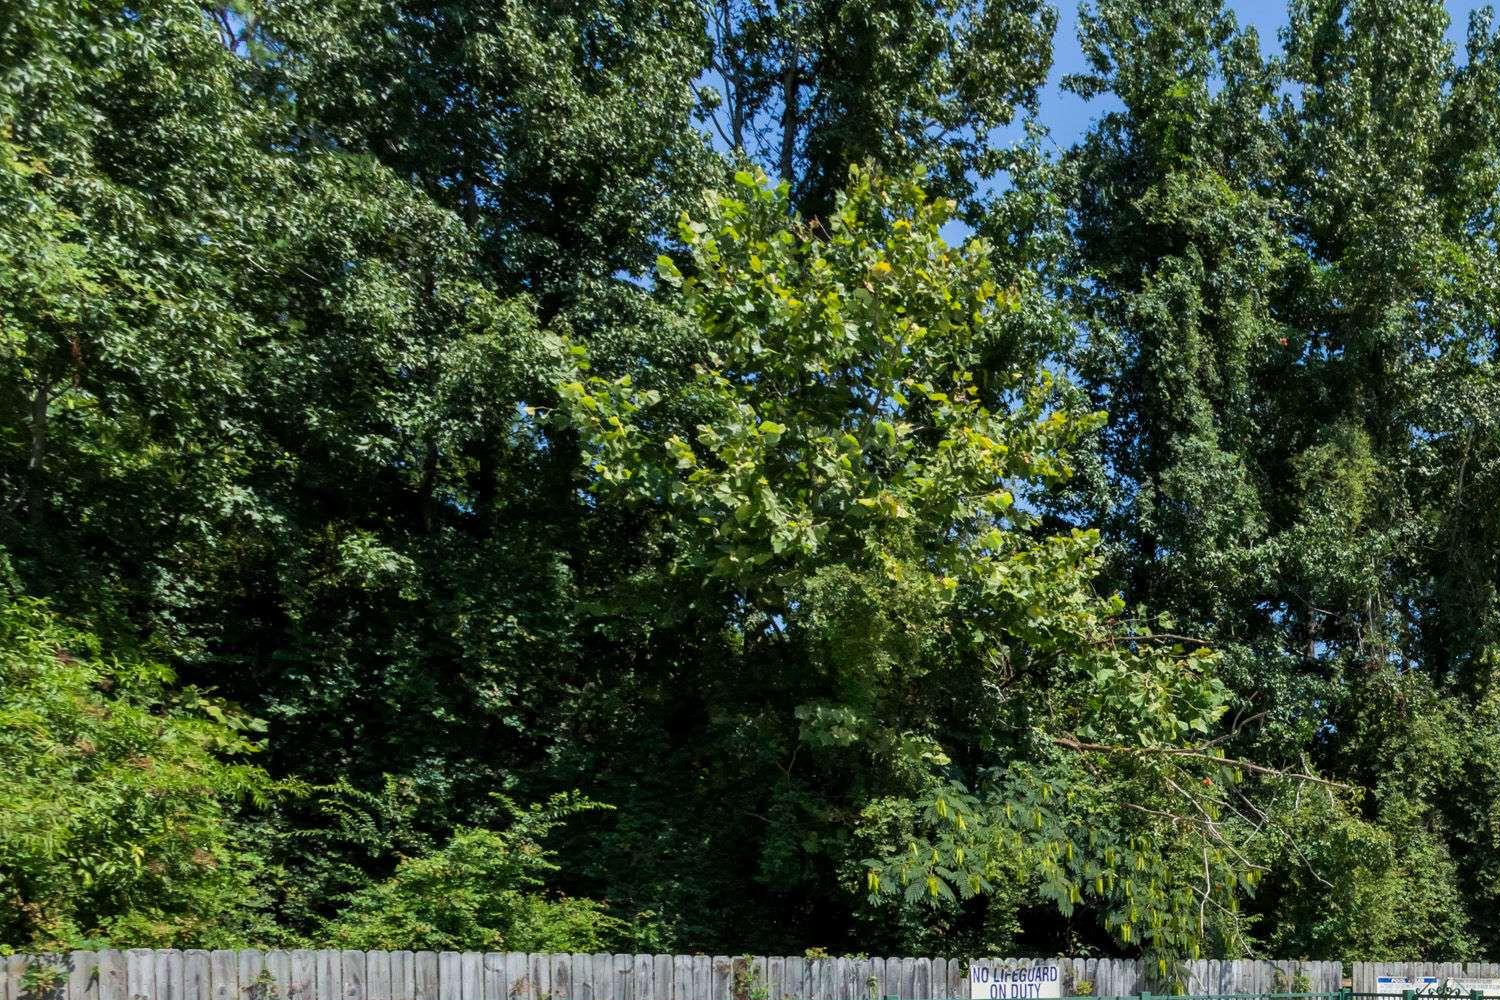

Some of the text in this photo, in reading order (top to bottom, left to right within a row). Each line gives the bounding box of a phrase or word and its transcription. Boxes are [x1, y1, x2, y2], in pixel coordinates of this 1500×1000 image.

[973, 966, 1058, 982] NO LIFEGUARD
[990, 983, 1041, 999] ON DUTY
